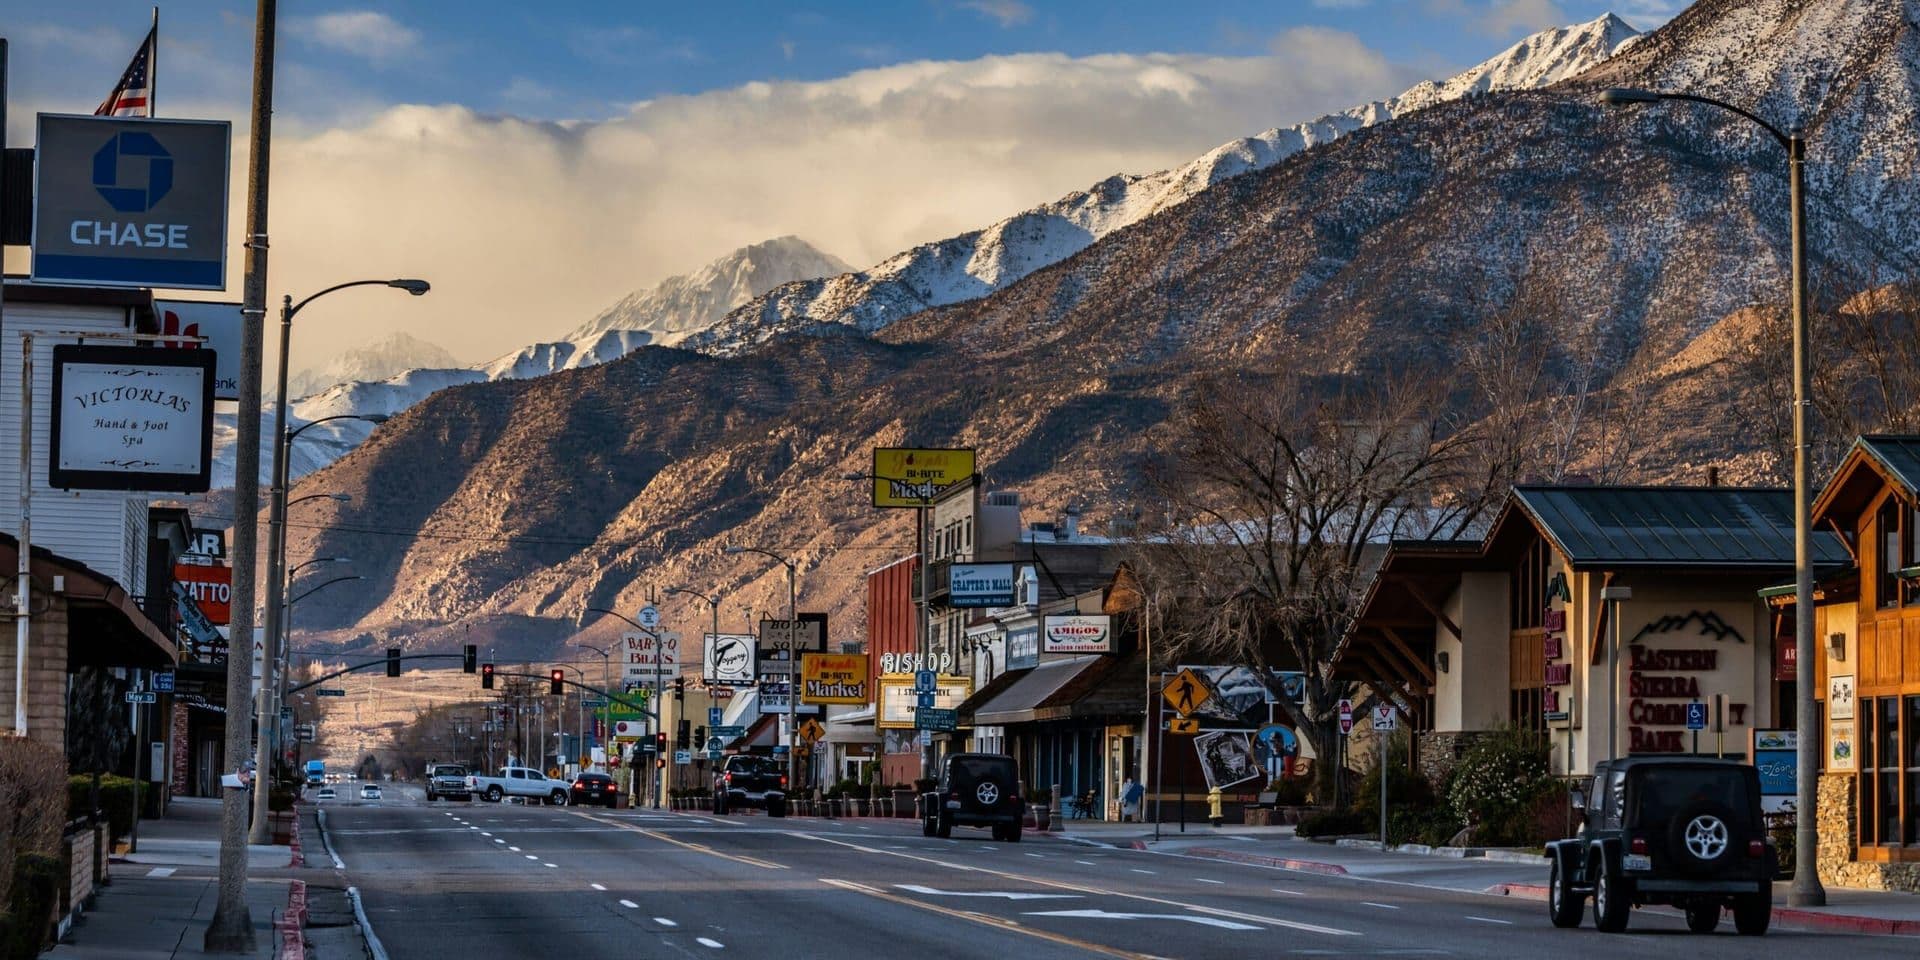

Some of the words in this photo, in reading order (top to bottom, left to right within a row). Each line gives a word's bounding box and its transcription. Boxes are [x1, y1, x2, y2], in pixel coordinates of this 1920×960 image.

[70, 220, 189, 250] CHASE
[75, 385, 191, 414] VICTORIA'S
[93, 418, 126, 430] Hand
[131, 422, 138, 430] &
[143, 420, 169, 431] Foot
[122, 434, 143, 448] Spa
[992, 578, 1012, 591] MALL
[1053, 627, 1100, 635] AMIGOS
[882, 652, 952, 674] BISHOP
[1629, 644, 1718, 671] EASTERN
[806, 680, 865, 698] Market
[1629, 671, 1701, 698] SIERRA
[1628, 726, 1685, 753] BANK
